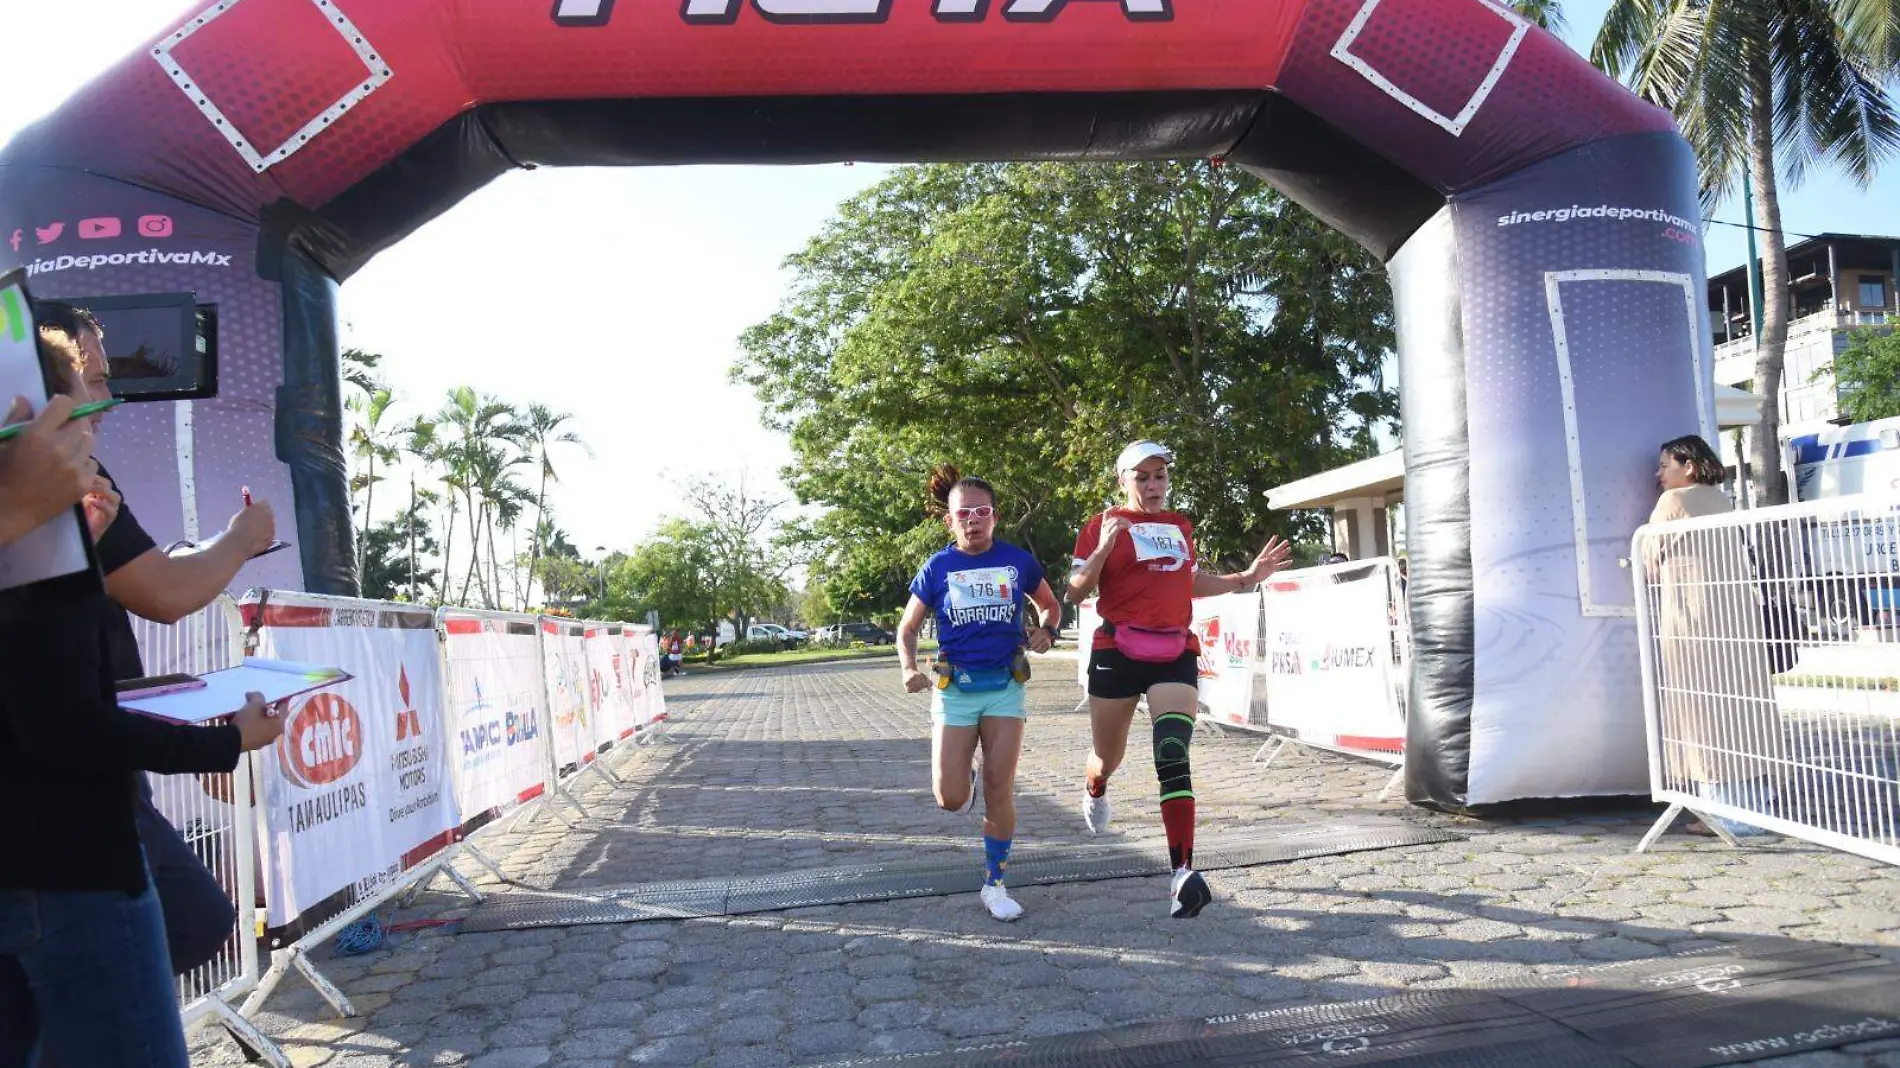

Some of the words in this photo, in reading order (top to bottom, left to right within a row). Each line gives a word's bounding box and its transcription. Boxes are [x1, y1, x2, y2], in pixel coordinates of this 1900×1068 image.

[1151, 536, 1173, 550] 187
[968, 583, 994, 598] 176
[943, 603, 1016, 628] WARRIORS
[301, 699, 354, 769] cmic
[288, 782, 367, 833] TAMAULIPAS
